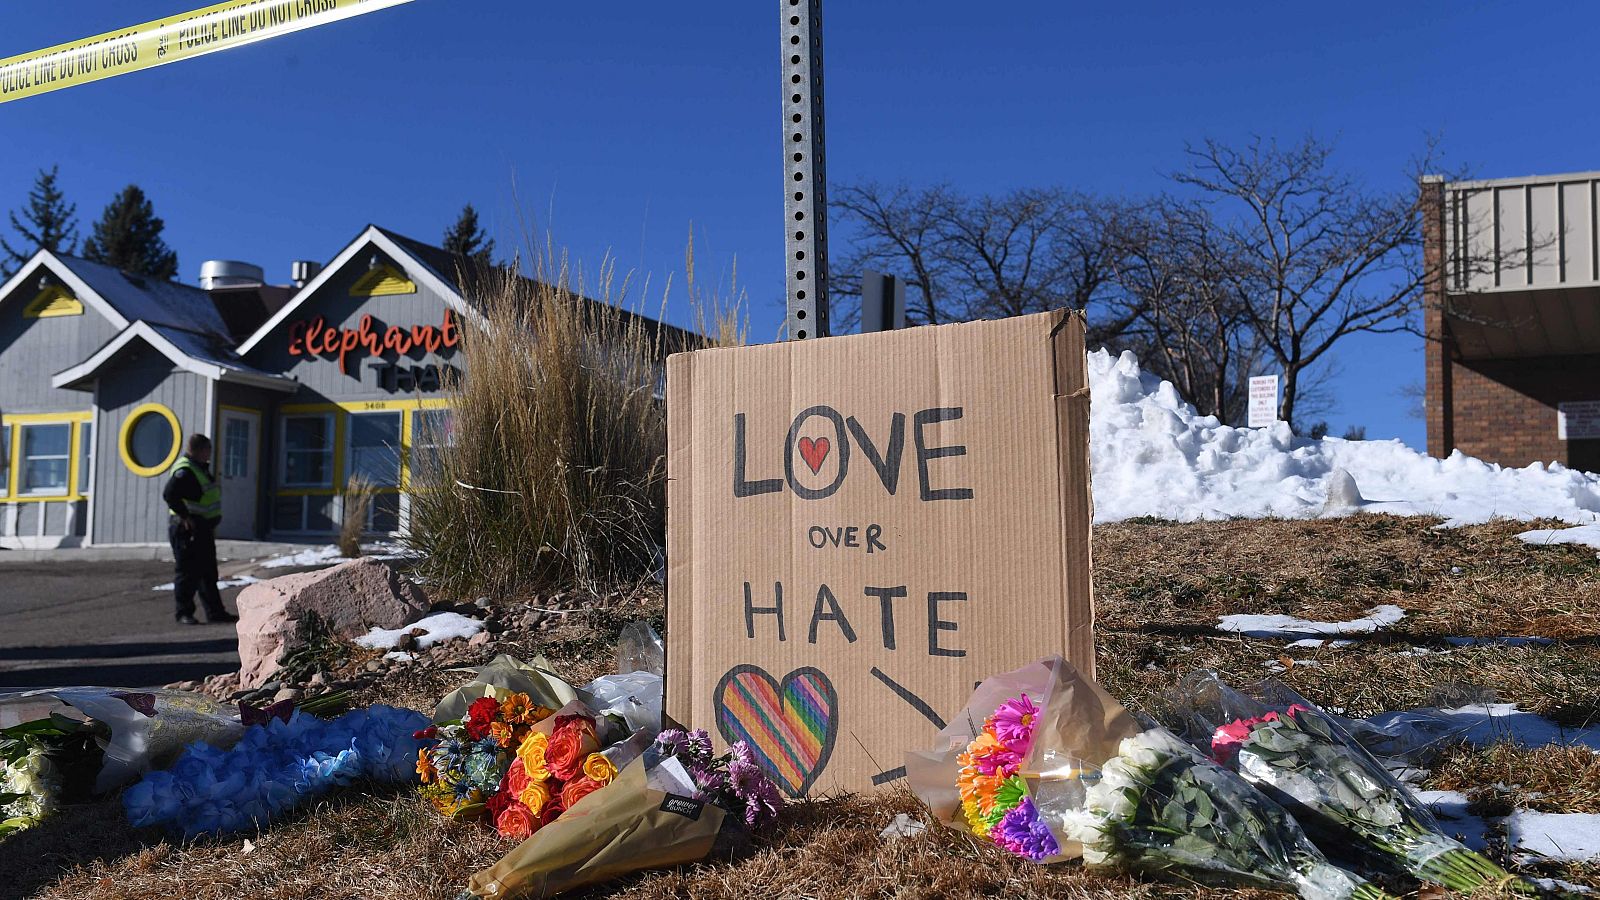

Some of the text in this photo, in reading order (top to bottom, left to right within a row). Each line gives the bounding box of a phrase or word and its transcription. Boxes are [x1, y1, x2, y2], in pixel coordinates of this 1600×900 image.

[180, 11, 219, 50] POLICE
[222, 4, 247, 39] LINE
[250, 0, 266, 32] DO
[270, 0, 292, 27] NOT
[34, 52, 58, 86] LINE
[60, 47, 75, 80] DO
[78, 41, 100, 75] NOT
[102, 31, 138, 69] CROSS
[288, 307, 460, 374] Elephant
[734, 405, 974, 501] LOVE
[808, 524, 886, 553] OVER
[744, 581, 967, 657] HATE
[667, 799, 698, 809] grower
